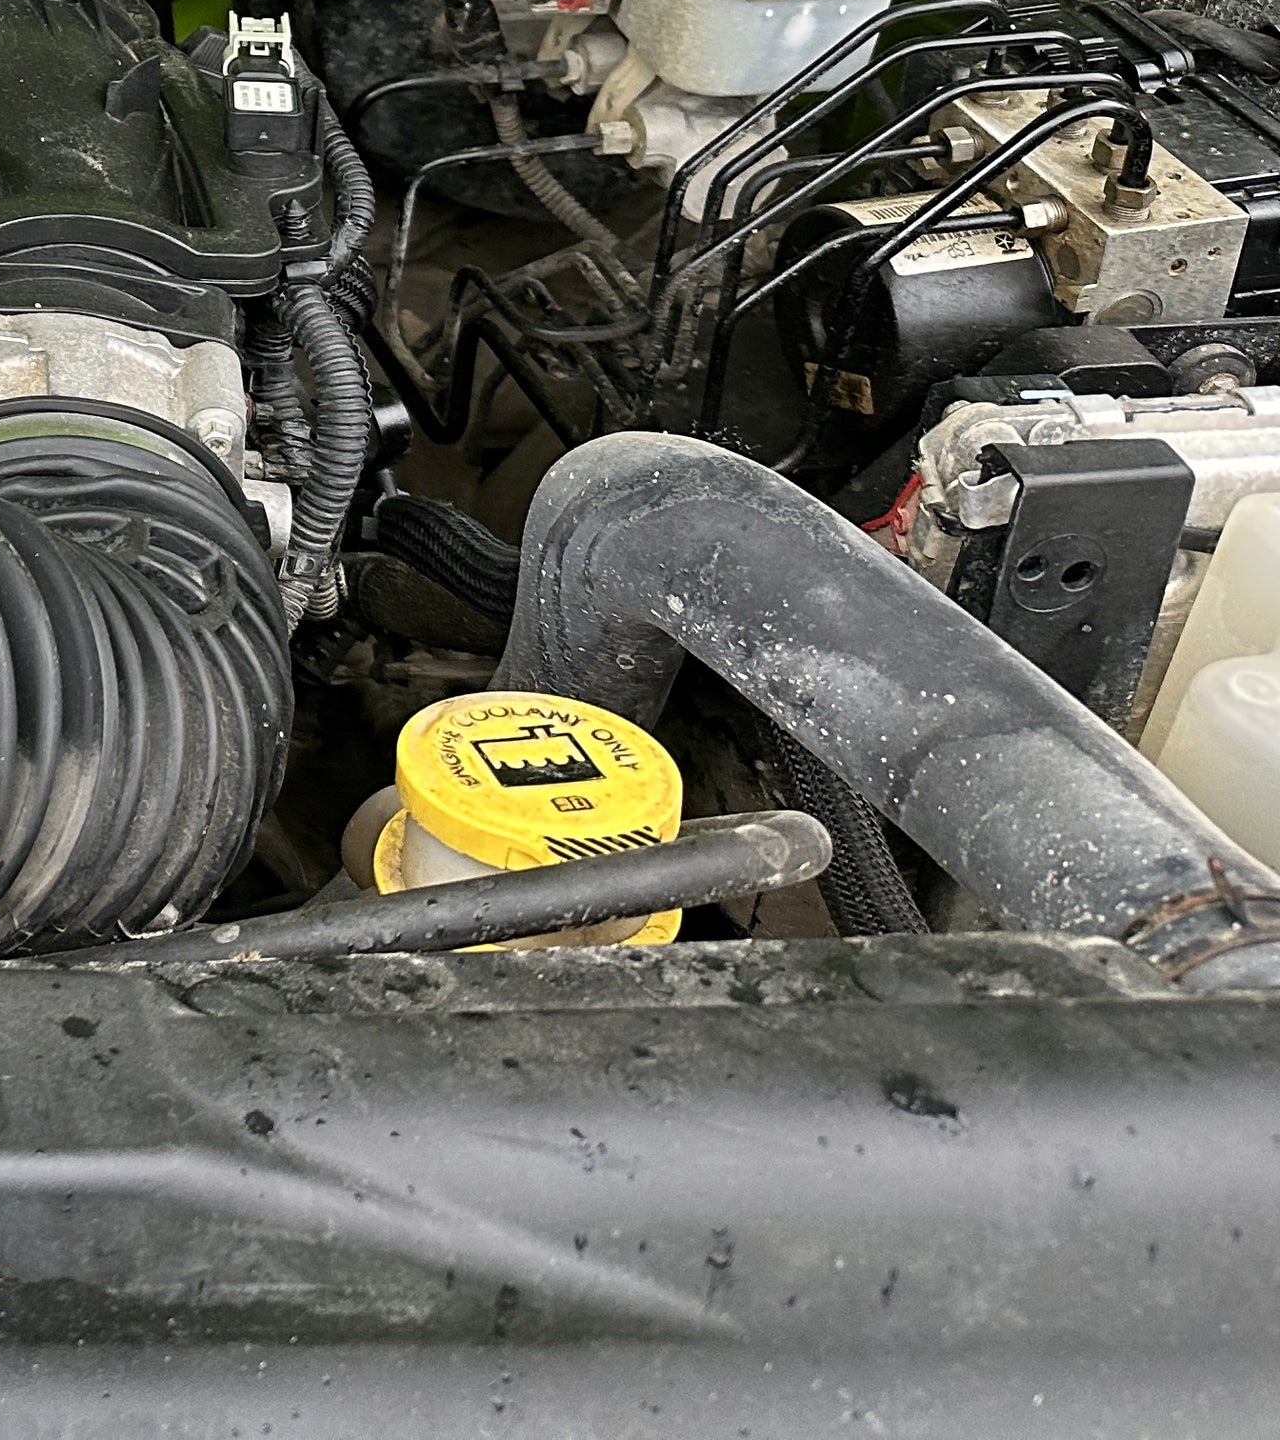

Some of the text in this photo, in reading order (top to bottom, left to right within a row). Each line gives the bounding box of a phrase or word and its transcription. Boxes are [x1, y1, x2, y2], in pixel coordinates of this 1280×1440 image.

[439, 705, 641, 789] ENGINE COOLANT ONLY
